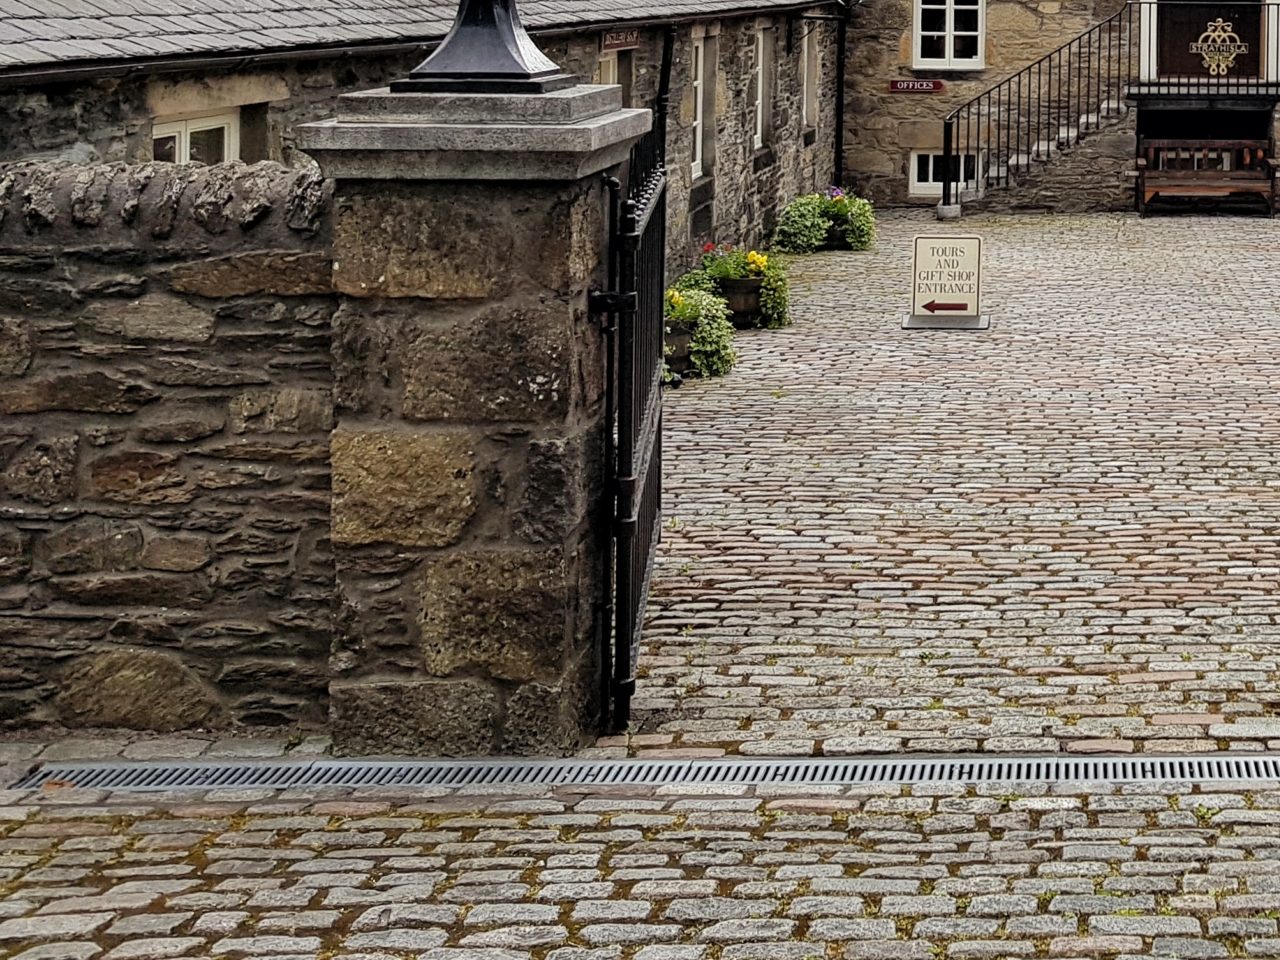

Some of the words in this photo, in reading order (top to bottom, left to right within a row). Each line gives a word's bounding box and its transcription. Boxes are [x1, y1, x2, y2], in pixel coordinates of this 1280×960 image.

[1191, 43, 1247, 52] STRATHISLA
[897, 81, 934, 90] OFFICES
[929, 246, 966, 257] TOURS
[935, 259, 960, 270] AND
[918, 270, 945, 281] GIFT
[947, 270, 975, 281] SHOP
[917, 283, 976, 294] ENTRANCE
